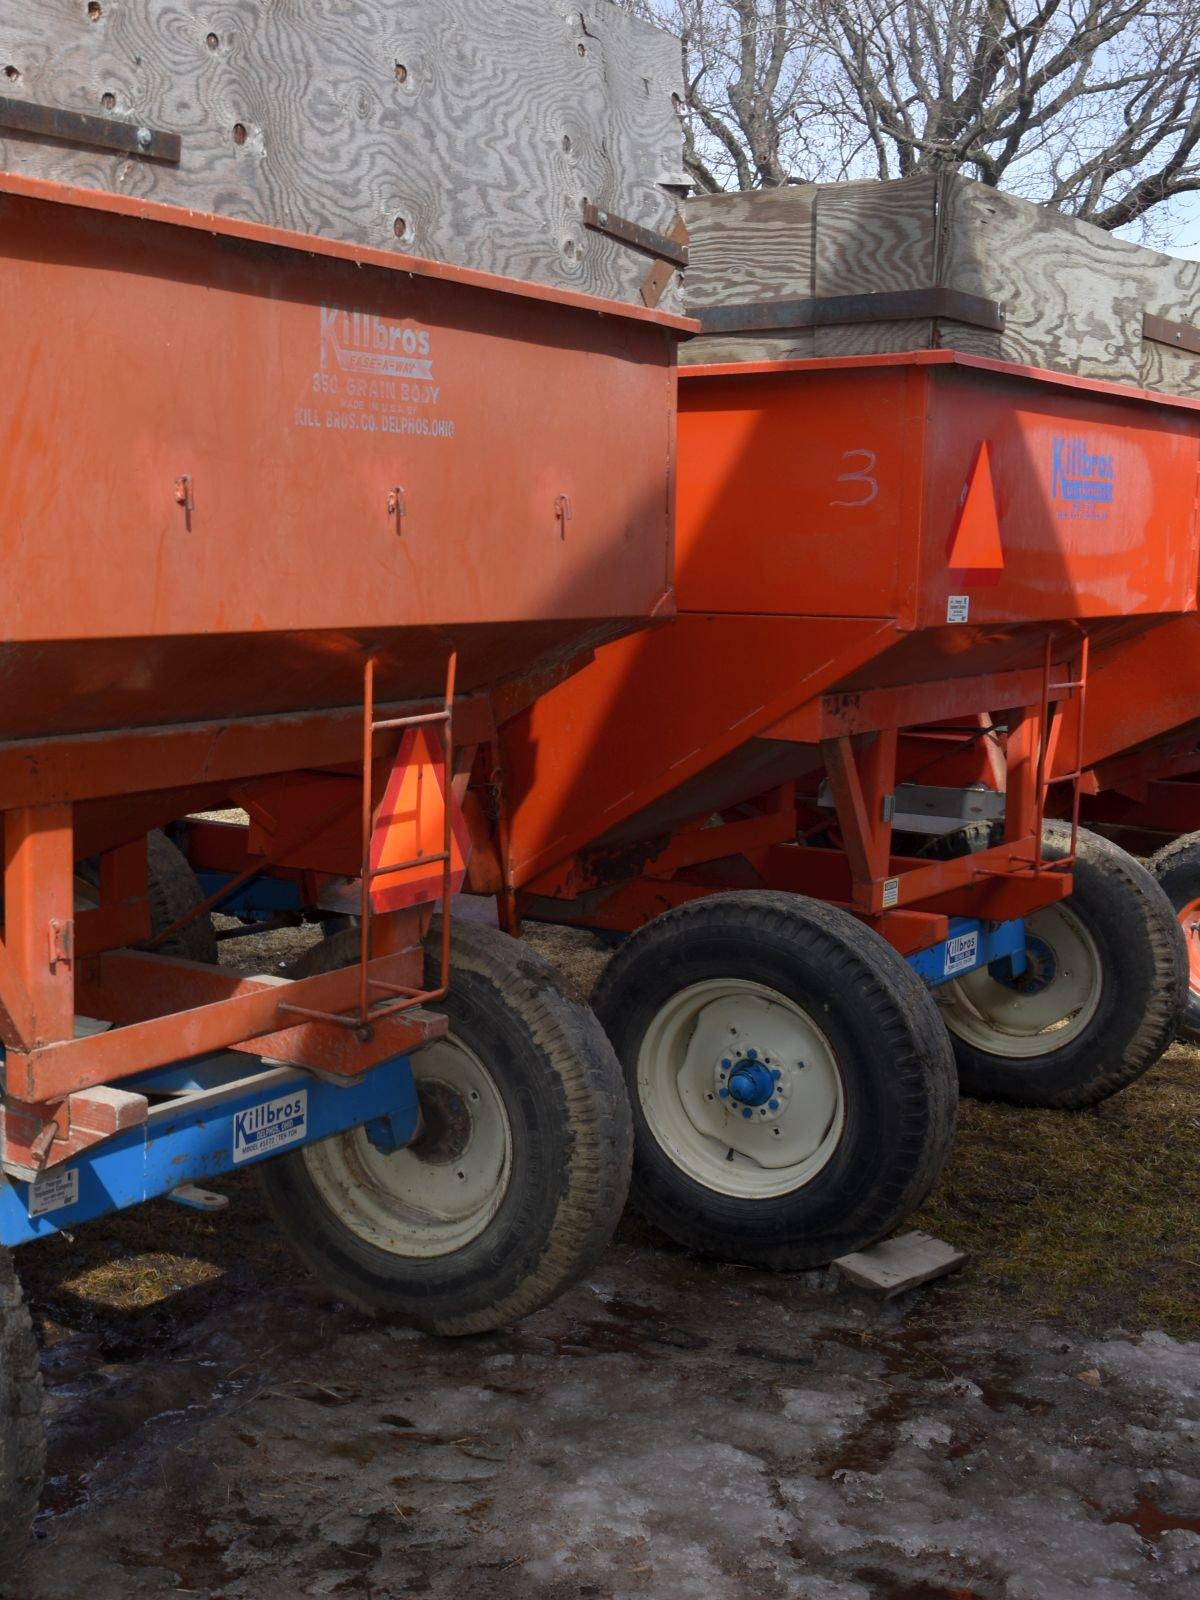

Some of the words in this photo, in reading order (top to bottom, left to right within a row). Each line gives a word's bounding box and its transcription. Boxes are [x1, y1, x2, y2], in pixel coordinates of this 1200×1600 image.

[319, 300, 431, 369] Killbros
[347, 378, 395, 399] GRAIN
[401, 384, 440, 405] BODY
[294, 407, 321, 427] KILL
[829, 448, 878, 507] 3
[1052, 436, 1114, 499] Killbros
[946, 937, 975, 966] Killbros
[235, 1099, 301, 1149] Killbros
